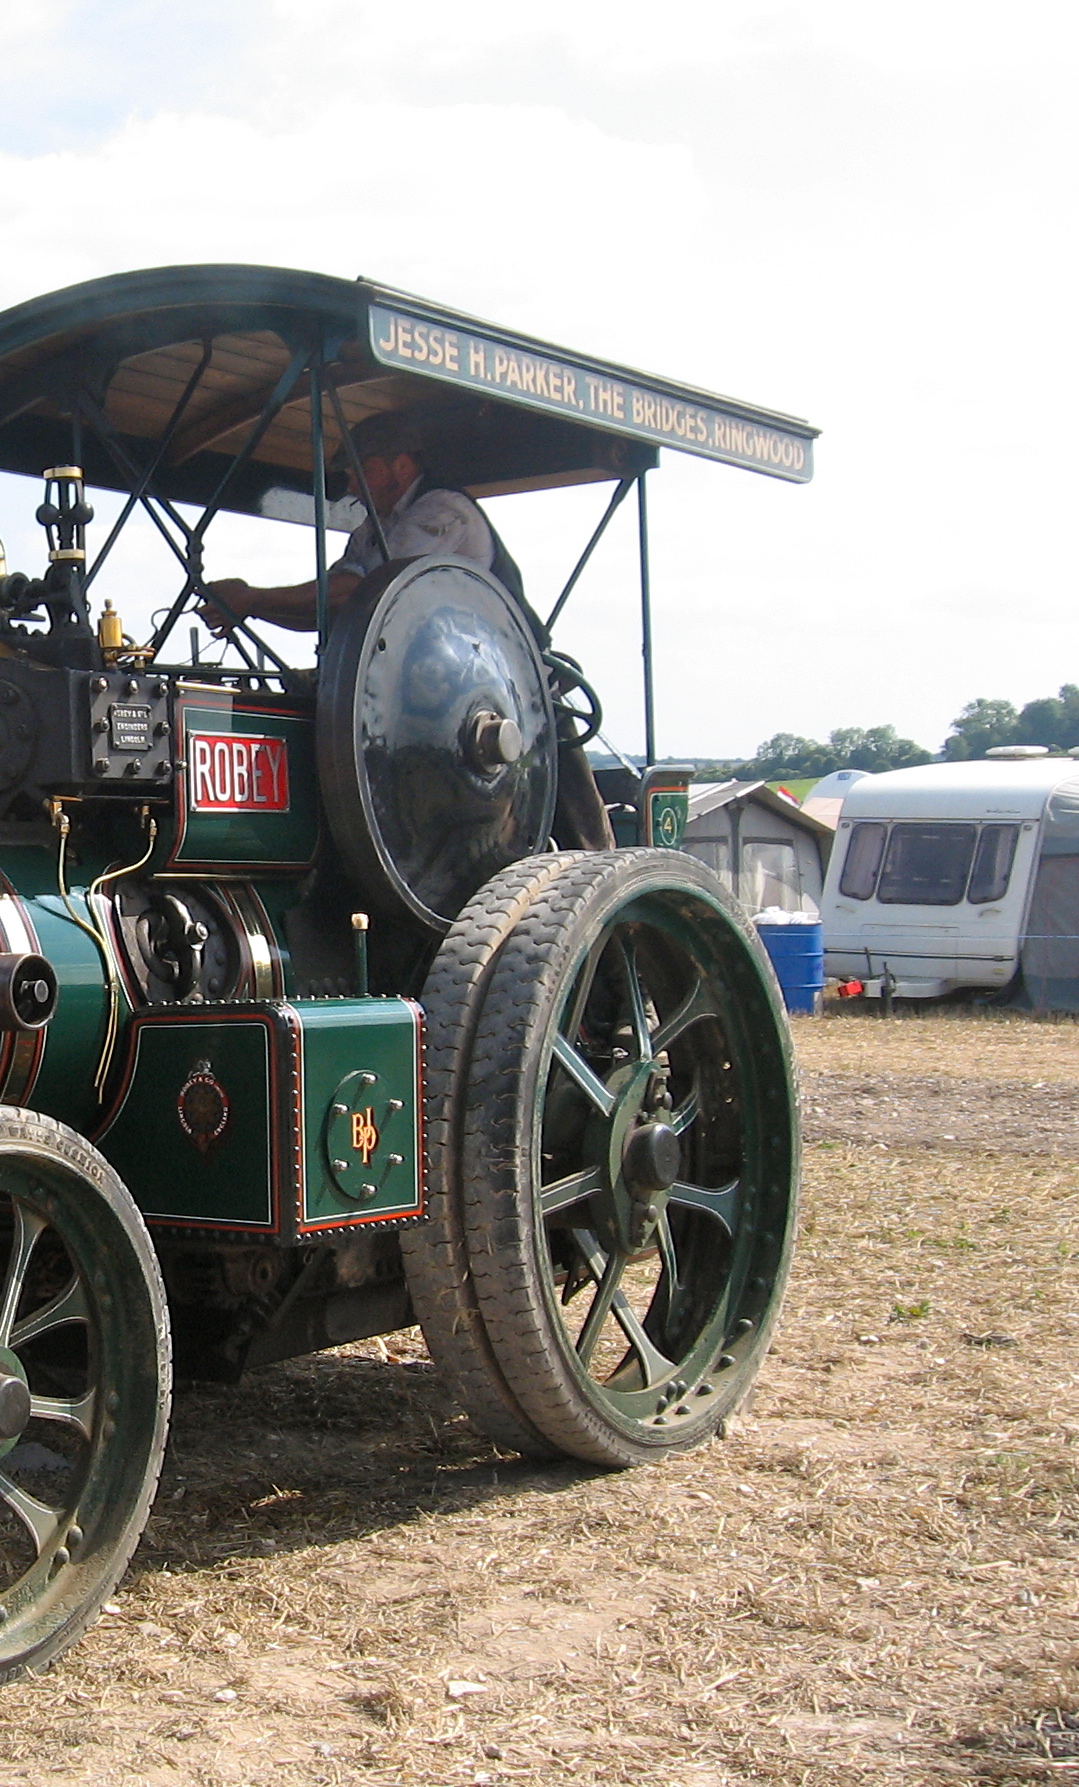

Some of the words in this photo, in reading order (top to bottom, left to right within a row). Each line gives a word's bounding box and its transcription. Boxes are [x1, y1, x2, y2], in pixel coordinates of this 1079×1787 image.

[380, 316, 459, 372] JESSE
[585, 376, 624, 420] THE
[715, 415, 805, 471] RINGWOOD
[195, 740, 283, 802] ROBEY
[663, 816, 673, 834] 4
